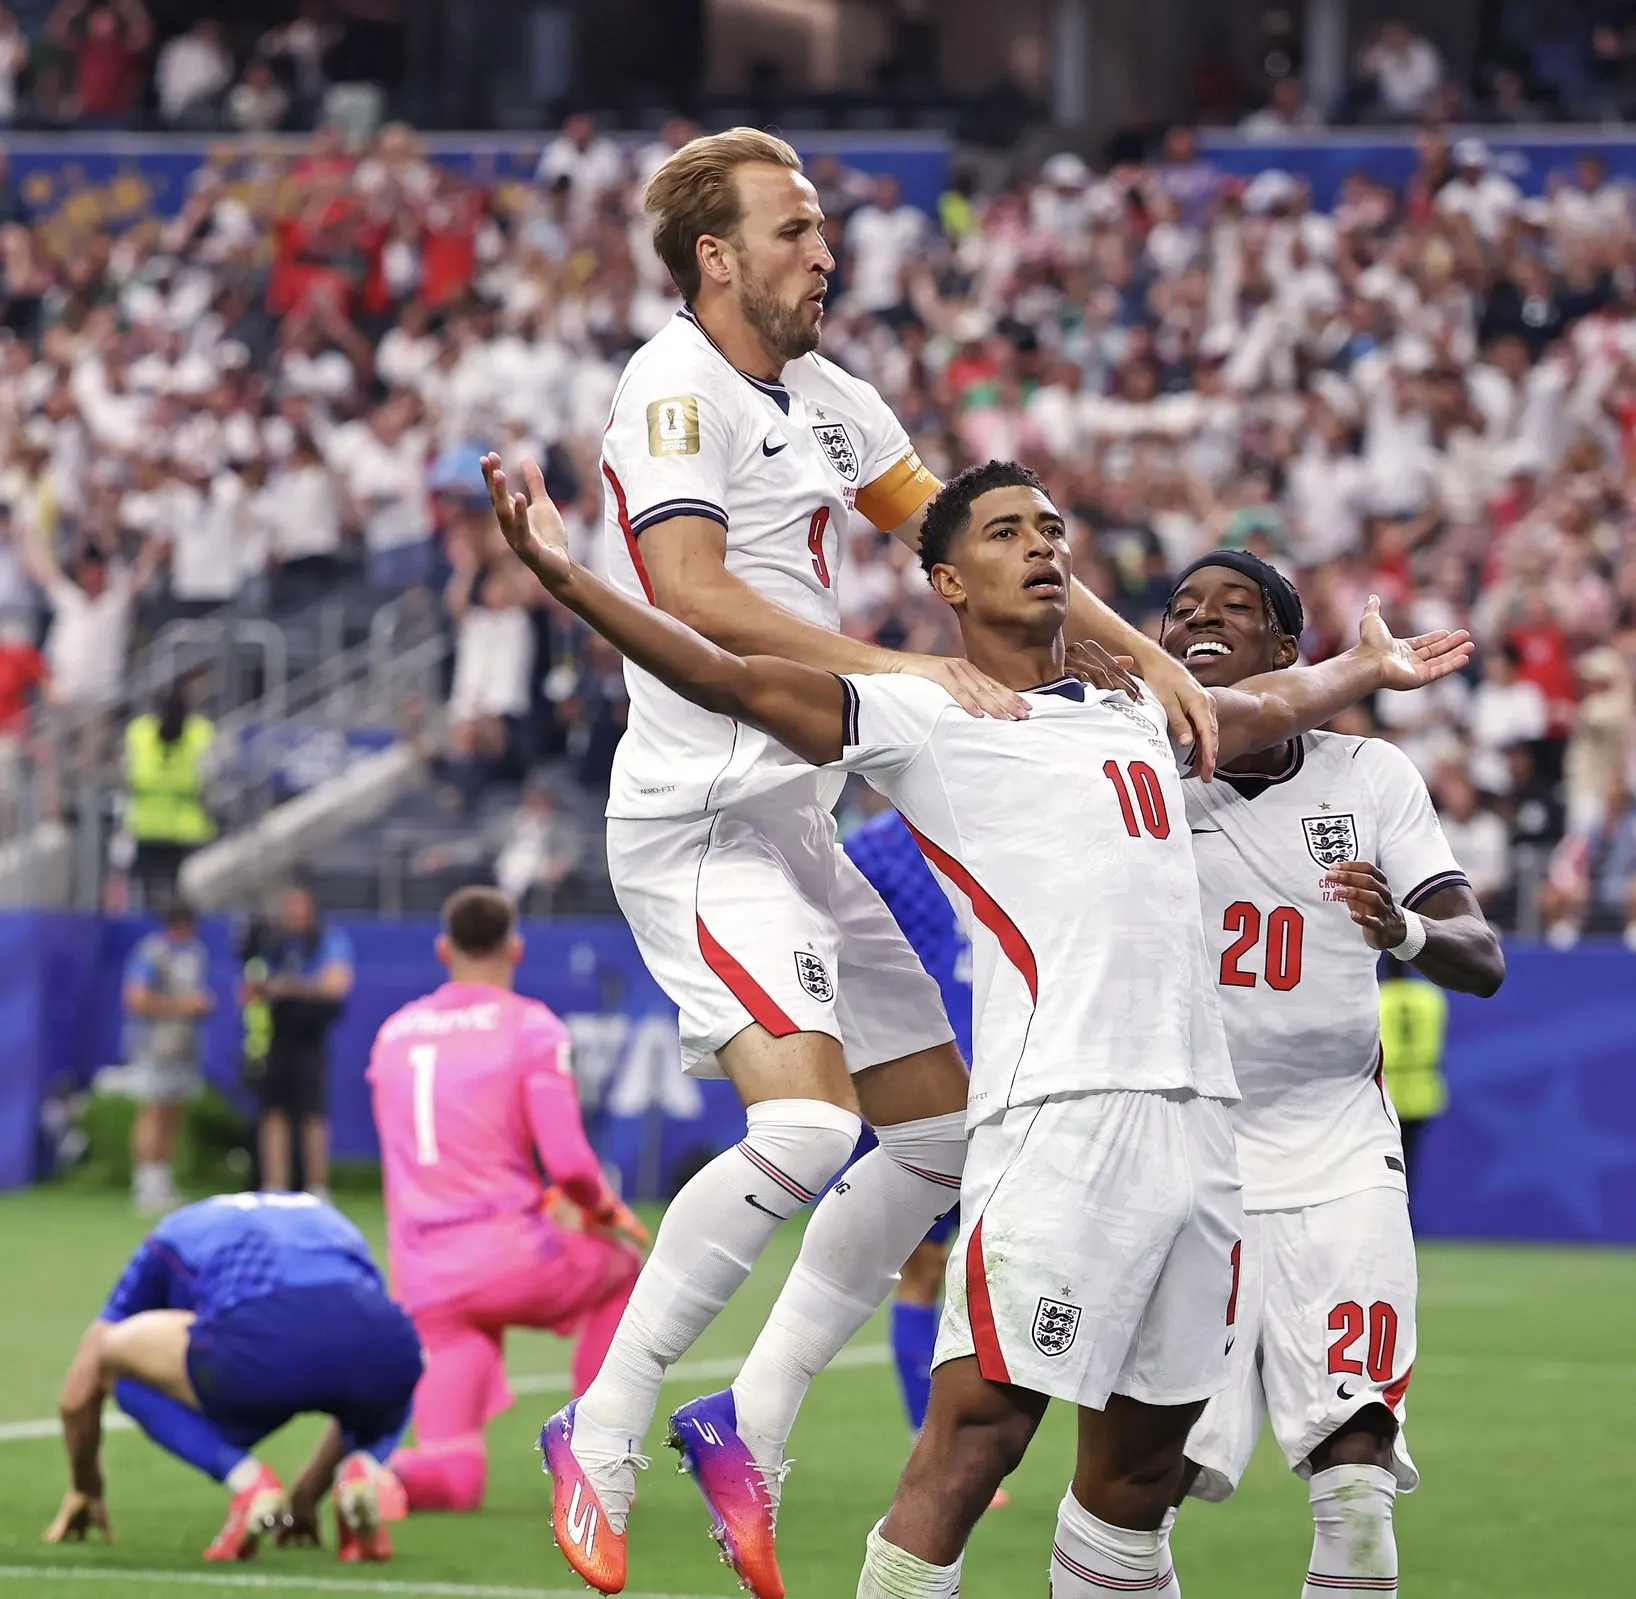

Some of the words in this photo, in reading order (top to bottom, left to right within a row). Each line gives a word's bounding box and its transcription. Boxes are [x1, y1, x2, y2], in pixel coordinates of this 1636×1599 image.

[807, 506, 830, 588] 9
[1103, 760, 1170, 840] 10
[1219, 901, 1304, 991] 20
[408, 1045, 438, 1166] 1
[1328, 1300, 1398, 1382] 20
